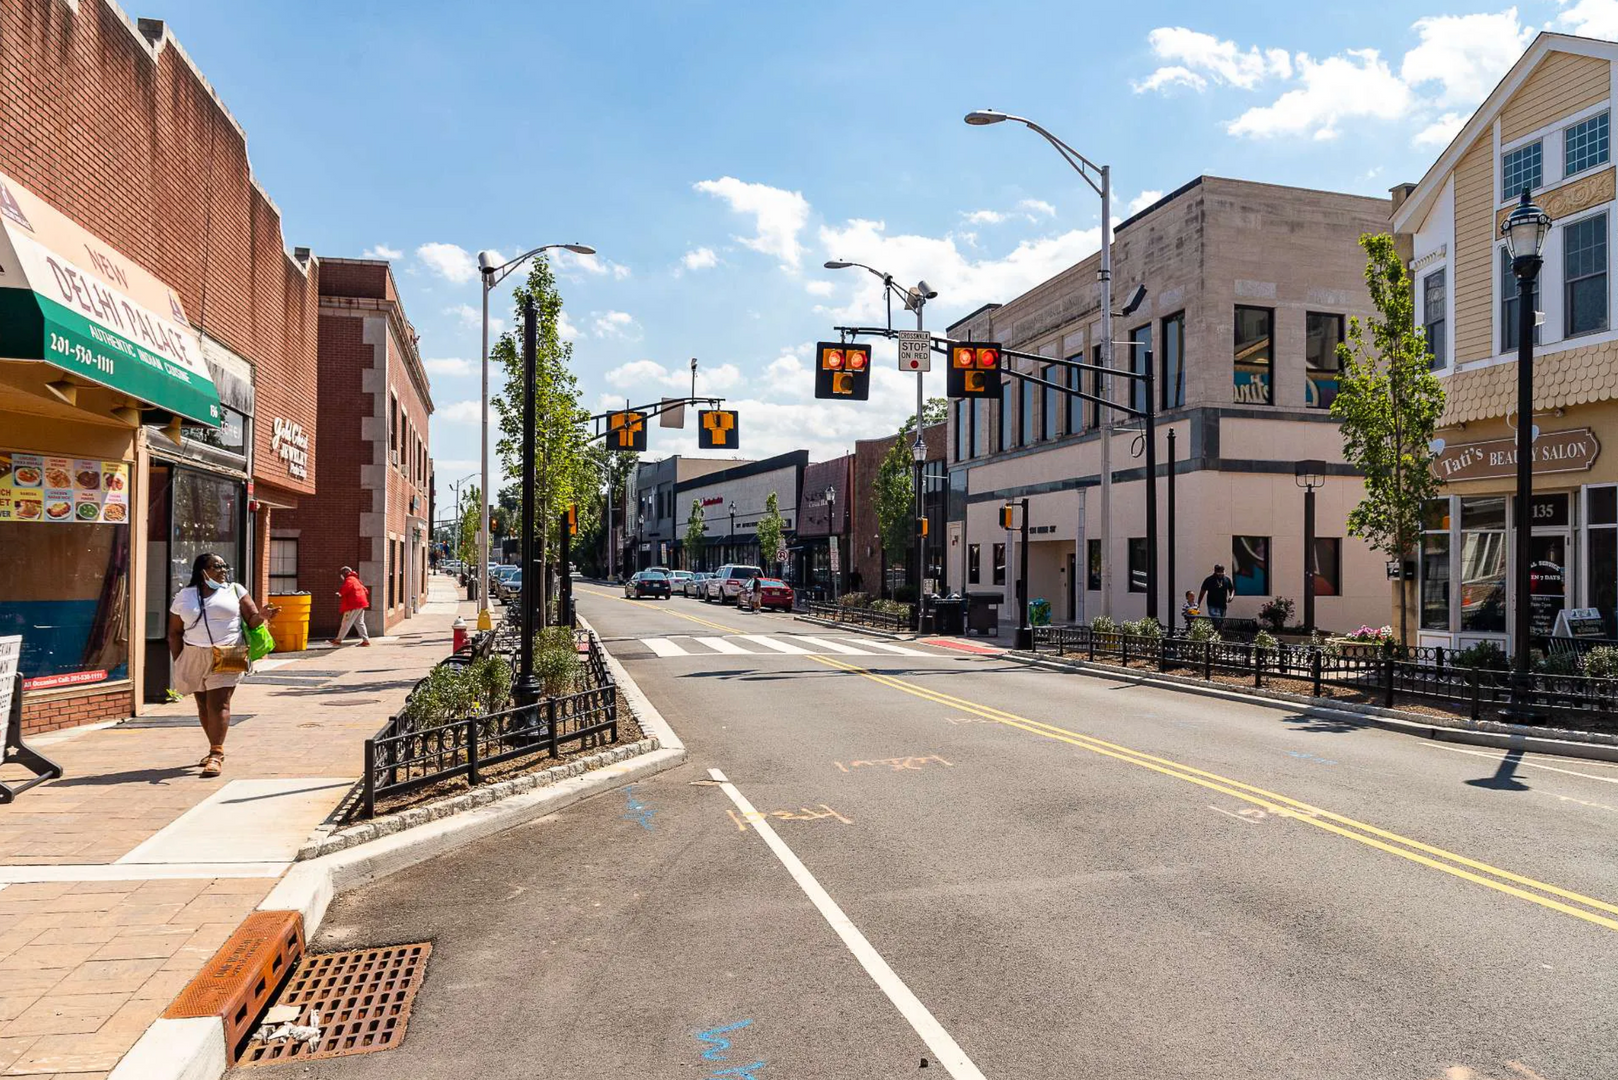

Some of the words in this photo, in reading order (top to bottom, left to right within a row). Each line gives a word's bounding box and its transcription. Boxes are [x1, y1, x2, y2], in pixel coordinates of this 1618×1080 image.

[84, 243, 129, 290] NEW
[46, 256, 124, 330] DELHI
[121, 300, 193, 366] PALACE
[50, 332, 114, 375] 201-530-1111
[89, 324, 136, 358] AUTHENTIC
[136, 348, 164, 371] INDIAN
[901, 332, 928, 340] CROSSWALK
[902, 342, 928, 351] STOP
[1441, 447, 1484, 476] Tati's
[1489, 447, 1539, 466] BEAUY
[1542, 441, 1587, 461] SALON
[1532, 504, 1554, 518] 135
